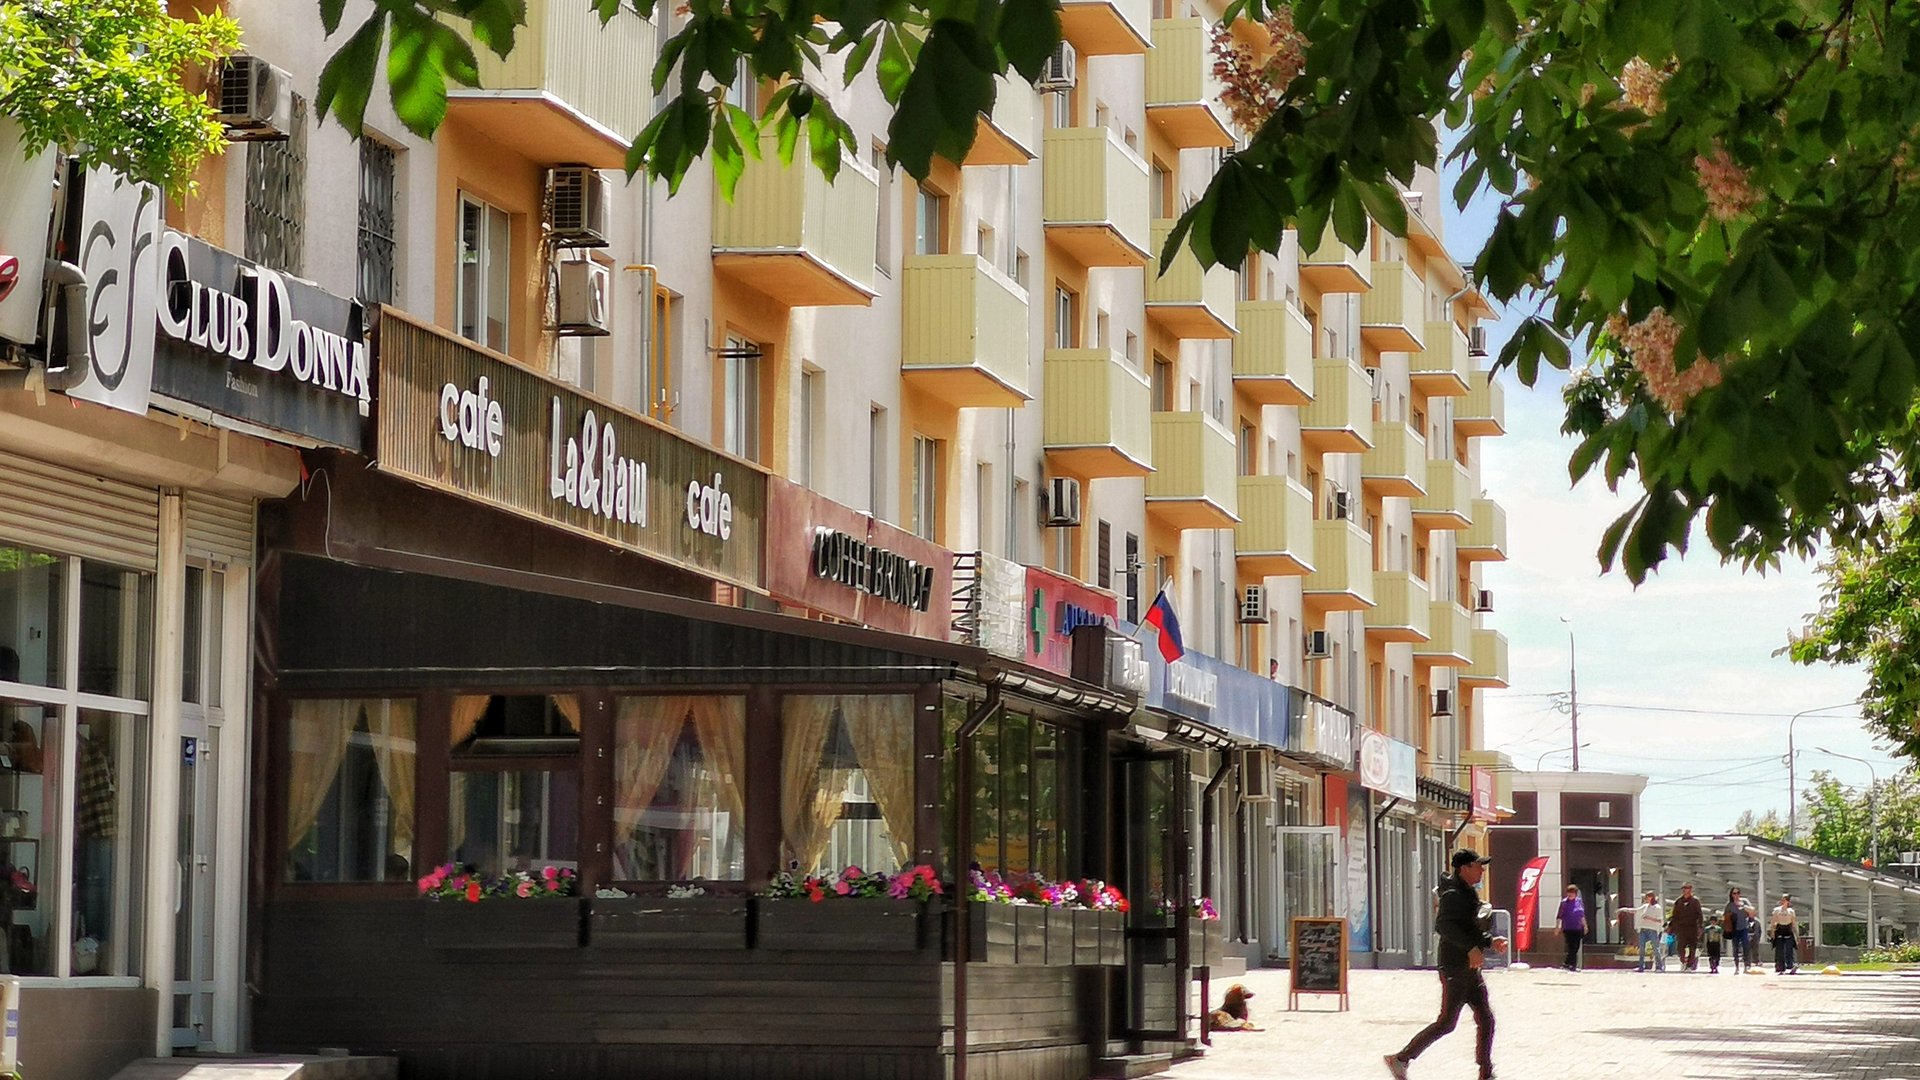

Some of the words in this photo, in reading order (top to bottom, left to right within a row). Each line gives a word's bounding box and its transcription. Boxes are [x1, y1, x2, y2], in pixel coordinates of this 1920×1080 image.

[155, 231, 250, 361] CLUB
[252, 265, 371, 402] DONNA
[440, 375, 503, 457] cafe
[687, 472, 733, 541] cafe
